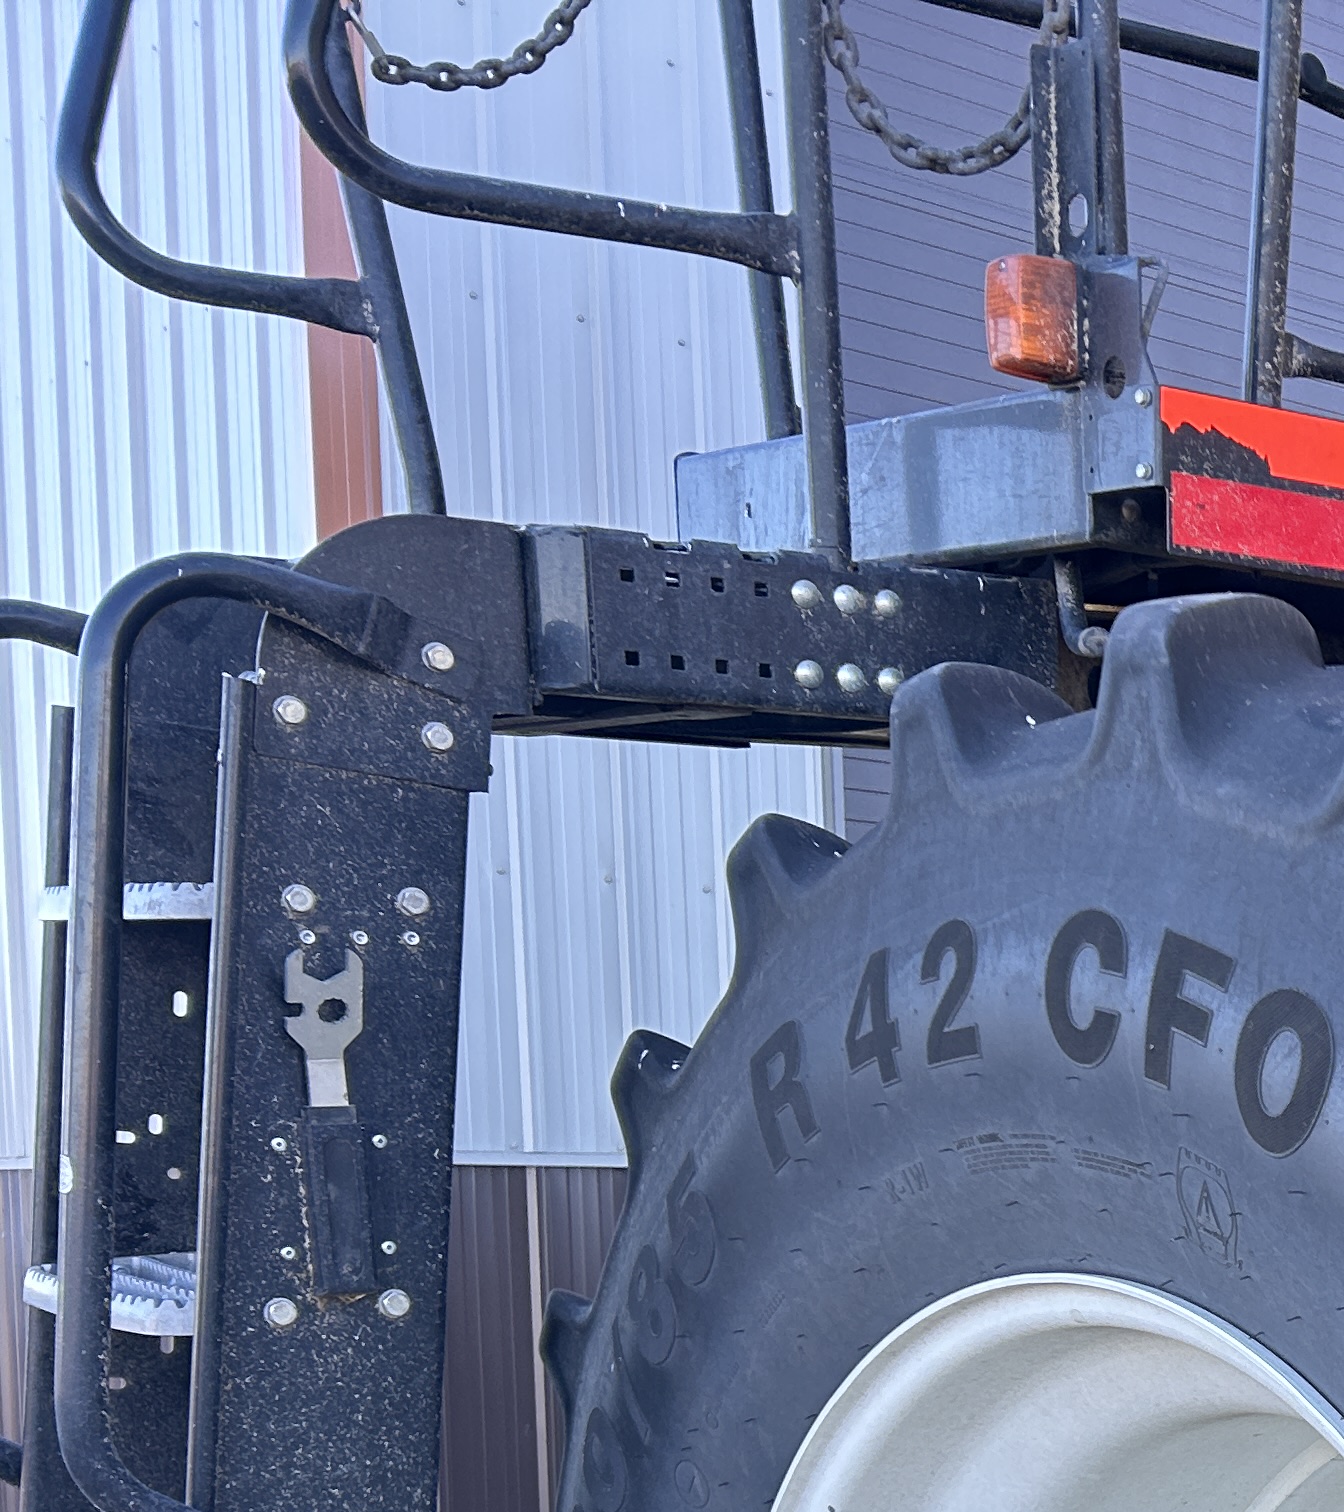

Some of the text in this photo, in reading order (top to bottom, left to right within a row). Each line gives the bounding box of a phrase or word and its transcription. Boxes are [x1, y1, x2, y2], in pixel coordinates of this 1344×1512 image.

[750, 1019, 821, 1173] R
[844, 918, 983, 1088] 42
[1044, 908, 1337, 1160] CFO
